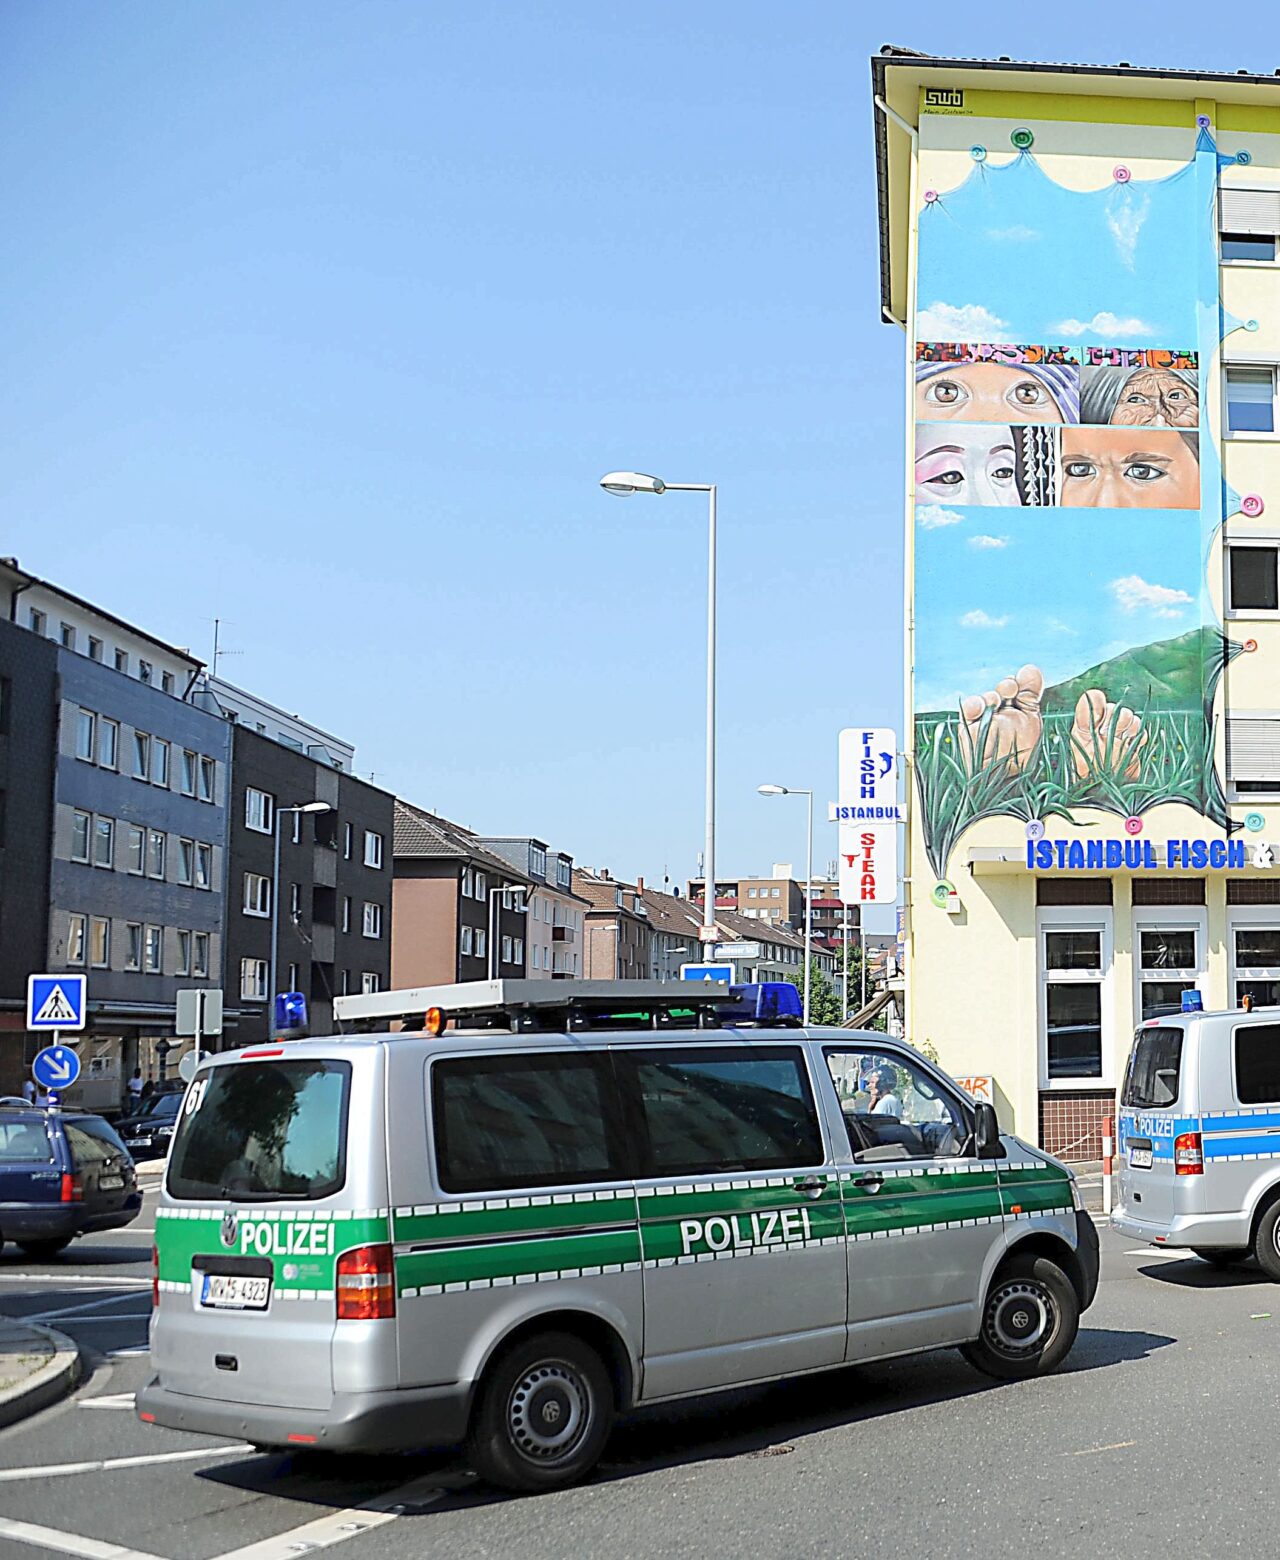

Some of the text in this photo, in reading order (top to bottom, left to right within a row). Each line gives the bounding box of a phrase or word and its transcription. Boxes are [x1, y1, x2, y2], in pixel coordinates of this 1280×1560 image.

[860, 732, 875, 799] FISCH
[836, 806, 902, 820] ISTANBUL
[860, 832, 876, 900] STEAK
[1027, 839, 1157, 869] ISTANBUL
[1167, 839, 1244, 869] FISCH
[1252, 839, 1275, 870] &
[185, 1079, 208, 1115] 61
[1140, 1118, 1174, 1138] POLIZEI
[240, 1222, 335, 1256] POLIZEI
[680, 1207, 811, 1254] POLIZEI
